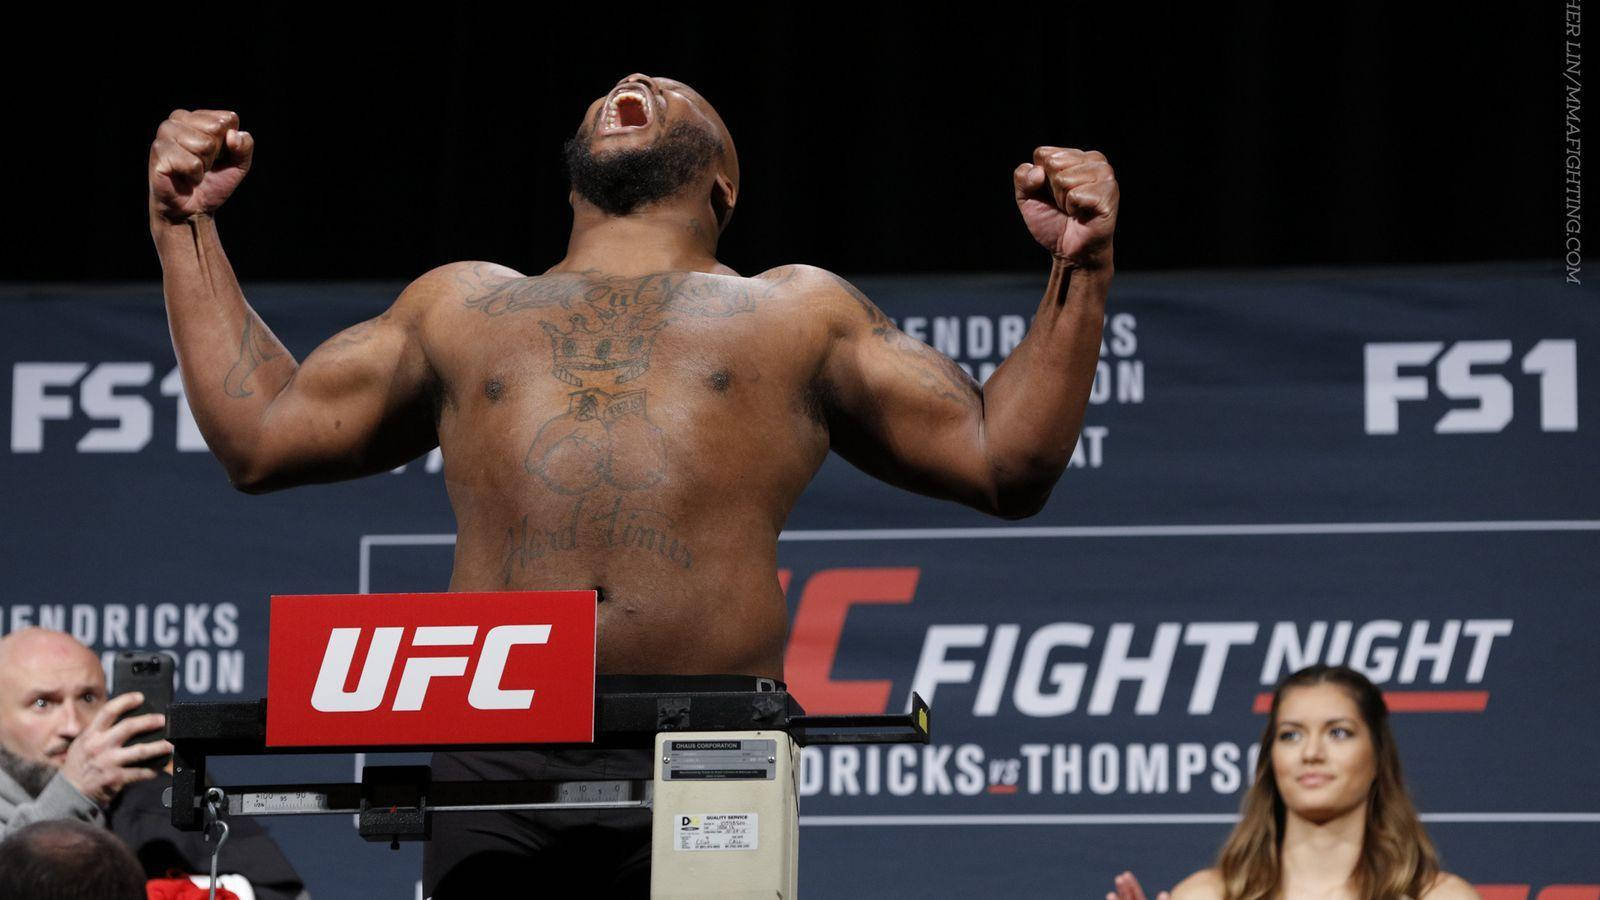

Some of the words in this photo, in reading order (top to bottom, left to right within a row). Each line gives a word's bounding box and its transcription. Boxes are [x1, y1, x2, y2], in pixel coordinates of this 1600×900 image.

[1363, 339, 1579, 435] FS1
[0, 603, 240, 648] ENDRICKS
[310, 624, 553, 713] UFC
[905, 622, 1259, 717] FIGHT
[1259, 619, 1514, 685] NIGHT
